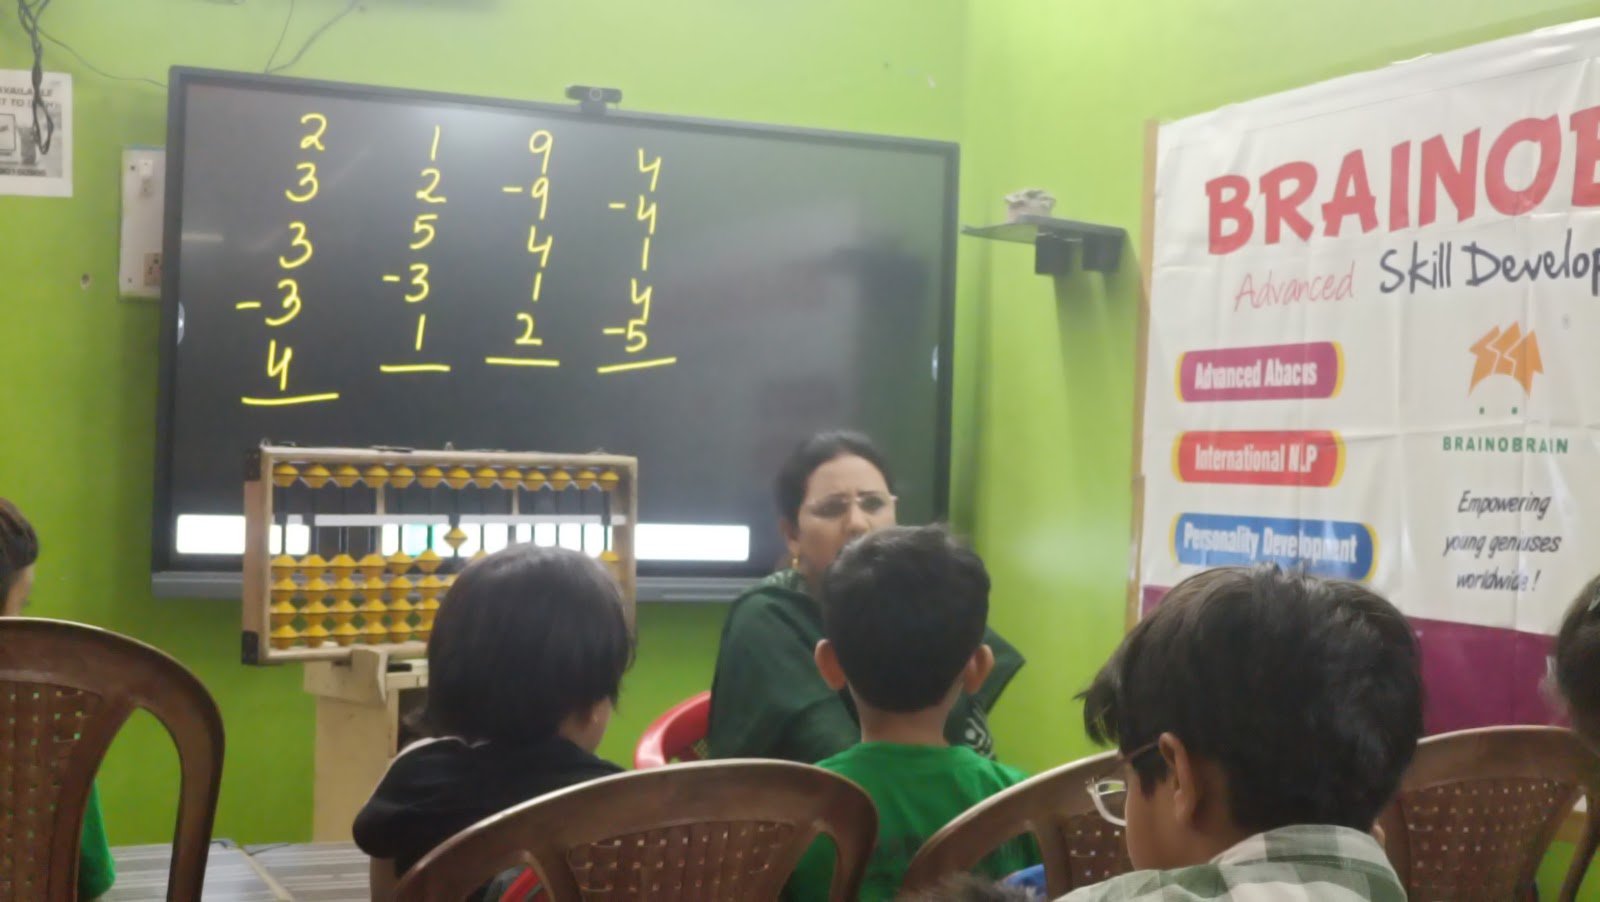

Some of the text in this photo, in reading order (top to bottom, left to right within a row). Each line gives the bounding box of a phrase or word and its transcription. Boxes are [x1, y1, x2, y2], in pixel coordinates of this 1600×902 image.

[300, 112, 328, 152] 2
[431, 125, 440, 161] 1
[530, 131, 553, 175] 9
[638, 148, 661, 192] 4
[285, 161, 320, 203] 3
[416, 168, 446, 203] 2
[503, 176, 549, 220] -9
[410, 213, 437, 250] 5
[608, 196, 657, 234] -4
[278, 220, 314, 270] 3
[527, 226, 553, 268] 4
[641, 236, 650, 271] 1
[383, 262, 430, 303] -3
[532, 271, 542, 302] 1
[1234, 260, 1355, 312] Advanced
[1379, 241, 1452, 294] Skill
[235, 277, 304, 327] -3
[631, 279, 652, 321] 4
[415, 314, 427, 351] 1
[515, 312, 544, 346] 2
[602, 318, 649, 353] -5
[265, 338, 294, 392] 4
[1194, 358, 1262, 390] Advanced
[1194, 443, 1286, 473] International
[1442, 436, 1569, 454] BRAINOBRAIN
[1457, 489, 1552, 521] Empowering
[1184, 521, 1358, 567] Personality Development
[1442, 531, 1563, 559] young geniuses
